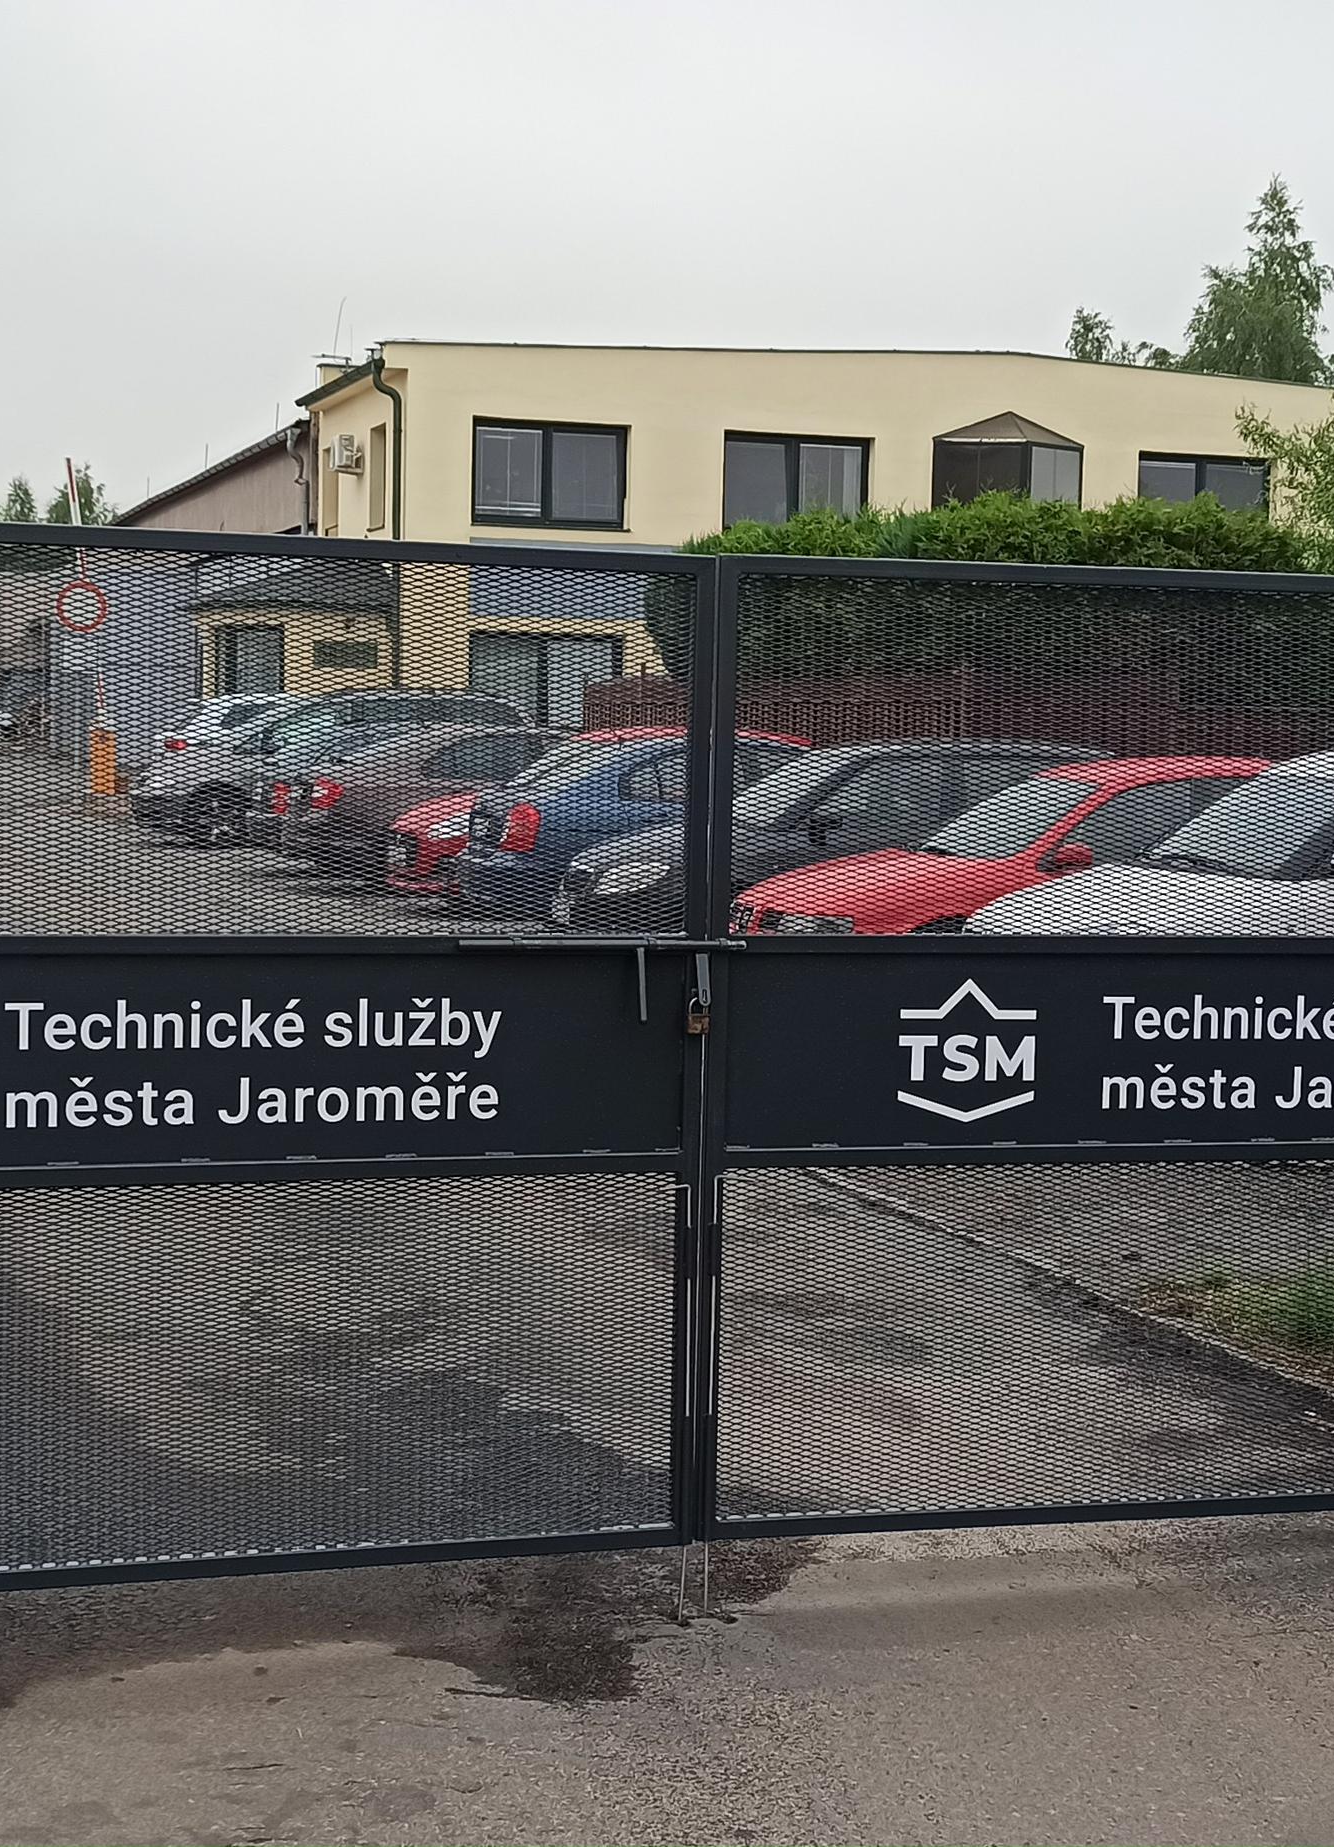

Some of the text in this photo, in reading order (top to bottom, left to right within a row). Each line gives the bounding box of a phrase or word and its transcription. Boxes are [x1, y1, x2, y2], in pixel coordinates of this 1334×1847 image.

[4, 997, 503, 1059] Technické služby
[898, 1034, 1037, 1082] TSM
[5, 1071, 500, 1129] města Jaroměře
[1101, 1063, 1256, 1110] města
